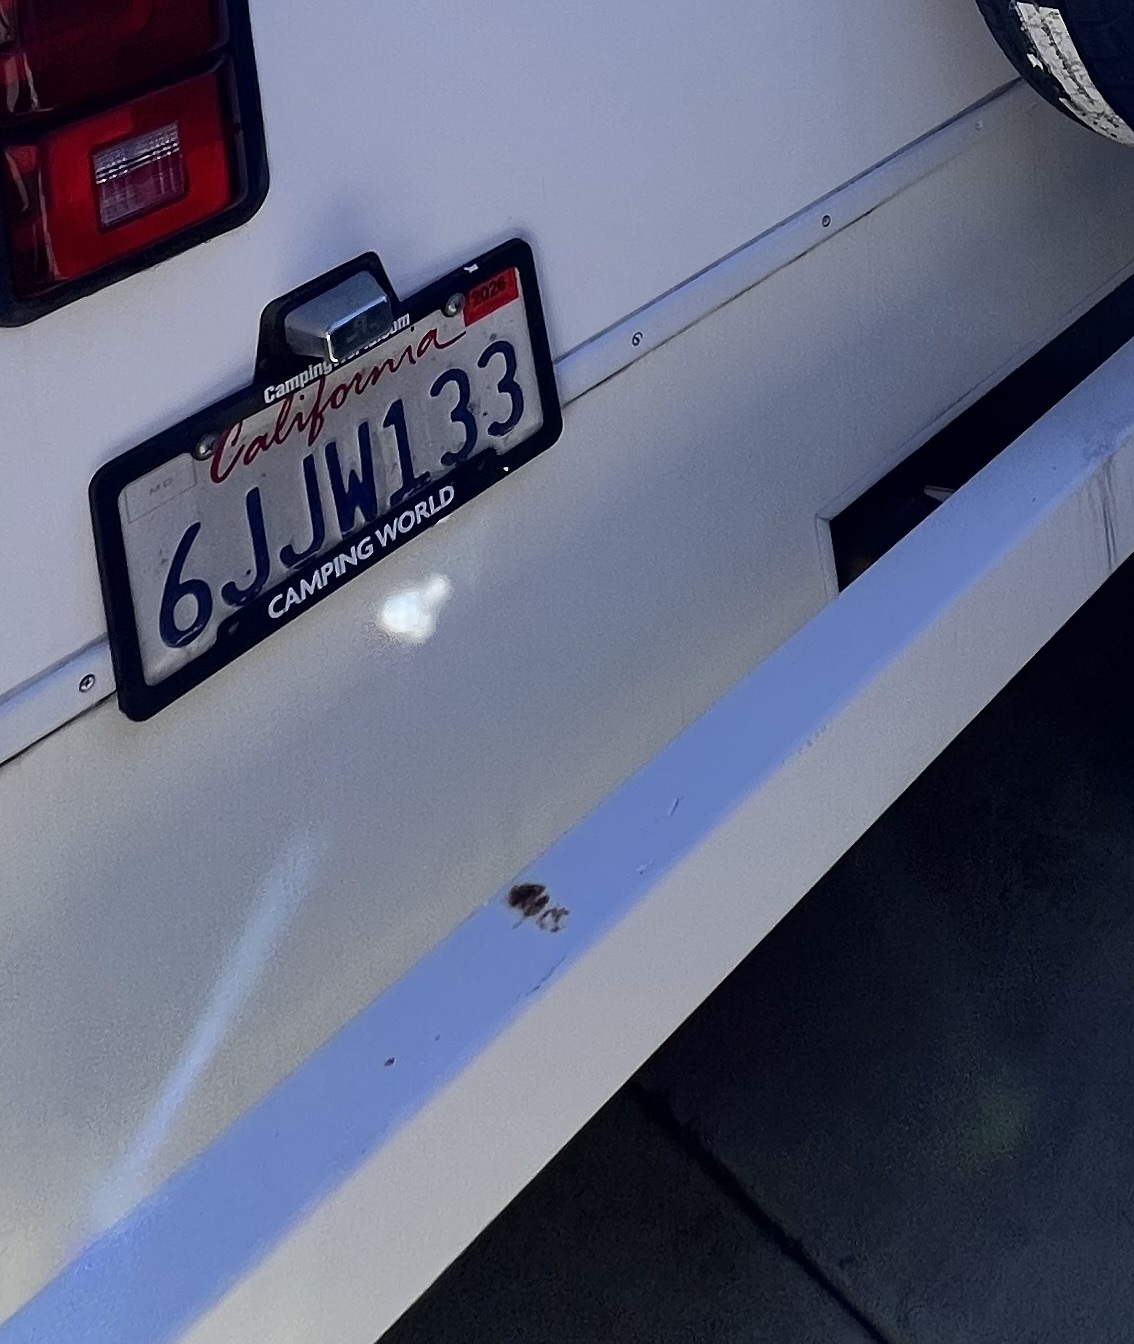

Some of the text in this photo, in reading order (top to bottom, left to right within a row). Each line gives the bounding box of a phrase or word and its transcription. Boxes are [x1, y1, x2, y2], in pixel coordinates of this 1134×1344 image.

[210, 326, 466, 484] California
[158, 340, 525, 649] 6JJW133
[267, 485, 456, 620] CAMPING WORLD
